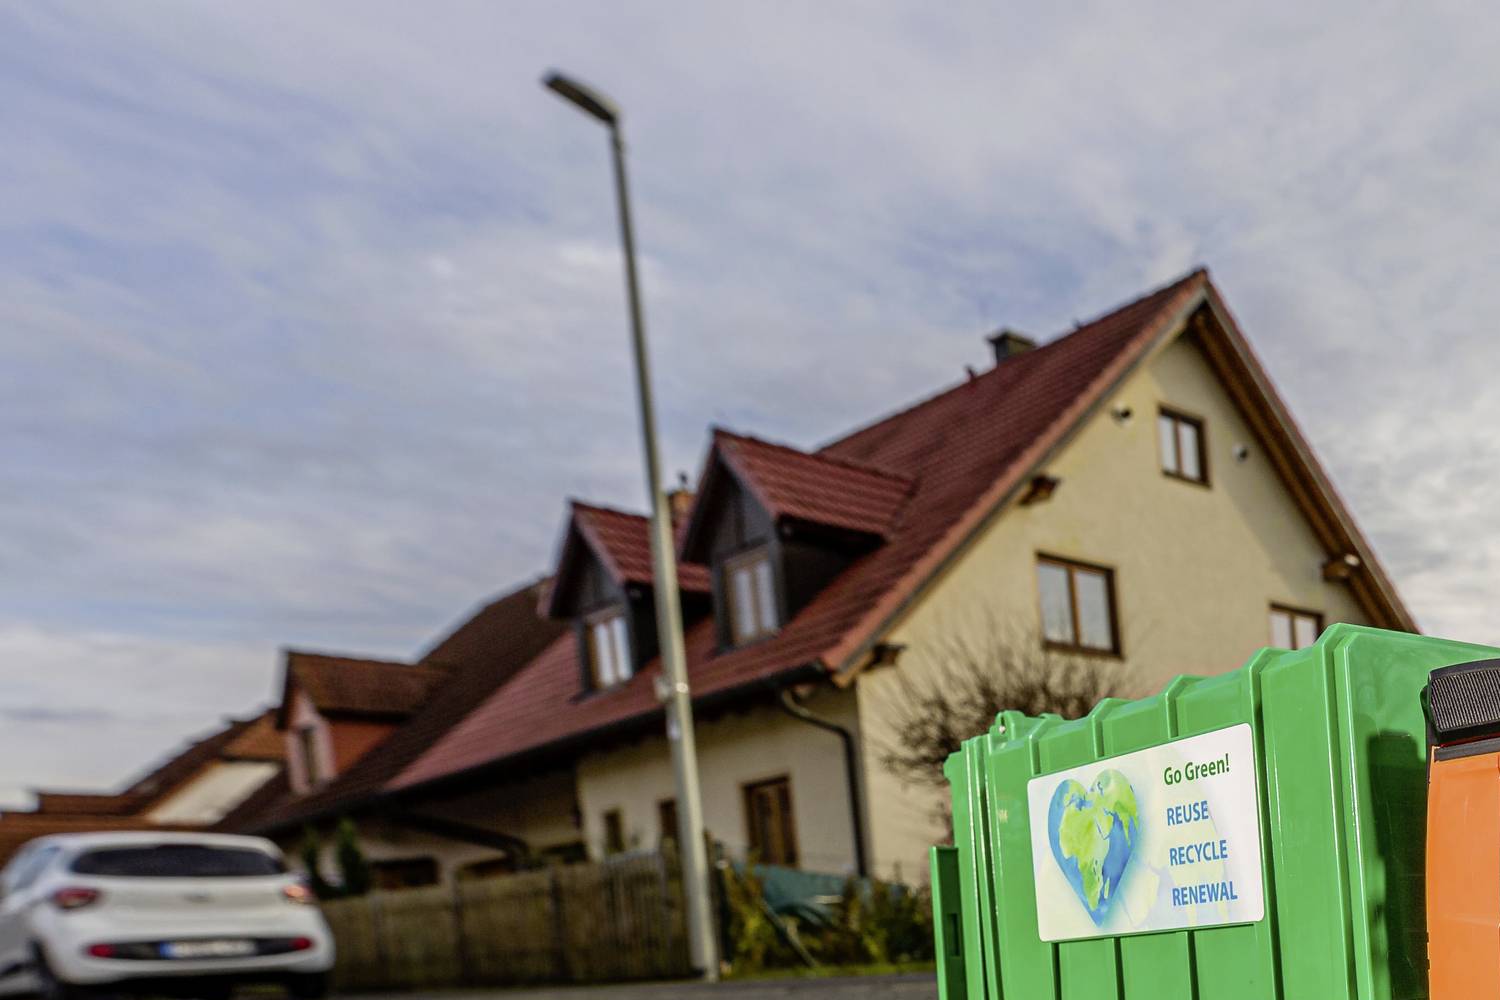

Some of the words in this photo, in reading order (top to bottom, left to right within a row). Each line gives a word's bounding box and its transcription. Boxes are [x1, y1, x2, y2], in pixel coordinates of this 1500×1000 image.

[1164, 766, 1182, 786] Go
[1184, 753, 1230, 780] Green!
[1167, 800, 1209, 826] REUSE
[1169, 839, 1228, 866] RECYCLE
[1172, 881, 1238, 906] RENEWAL
